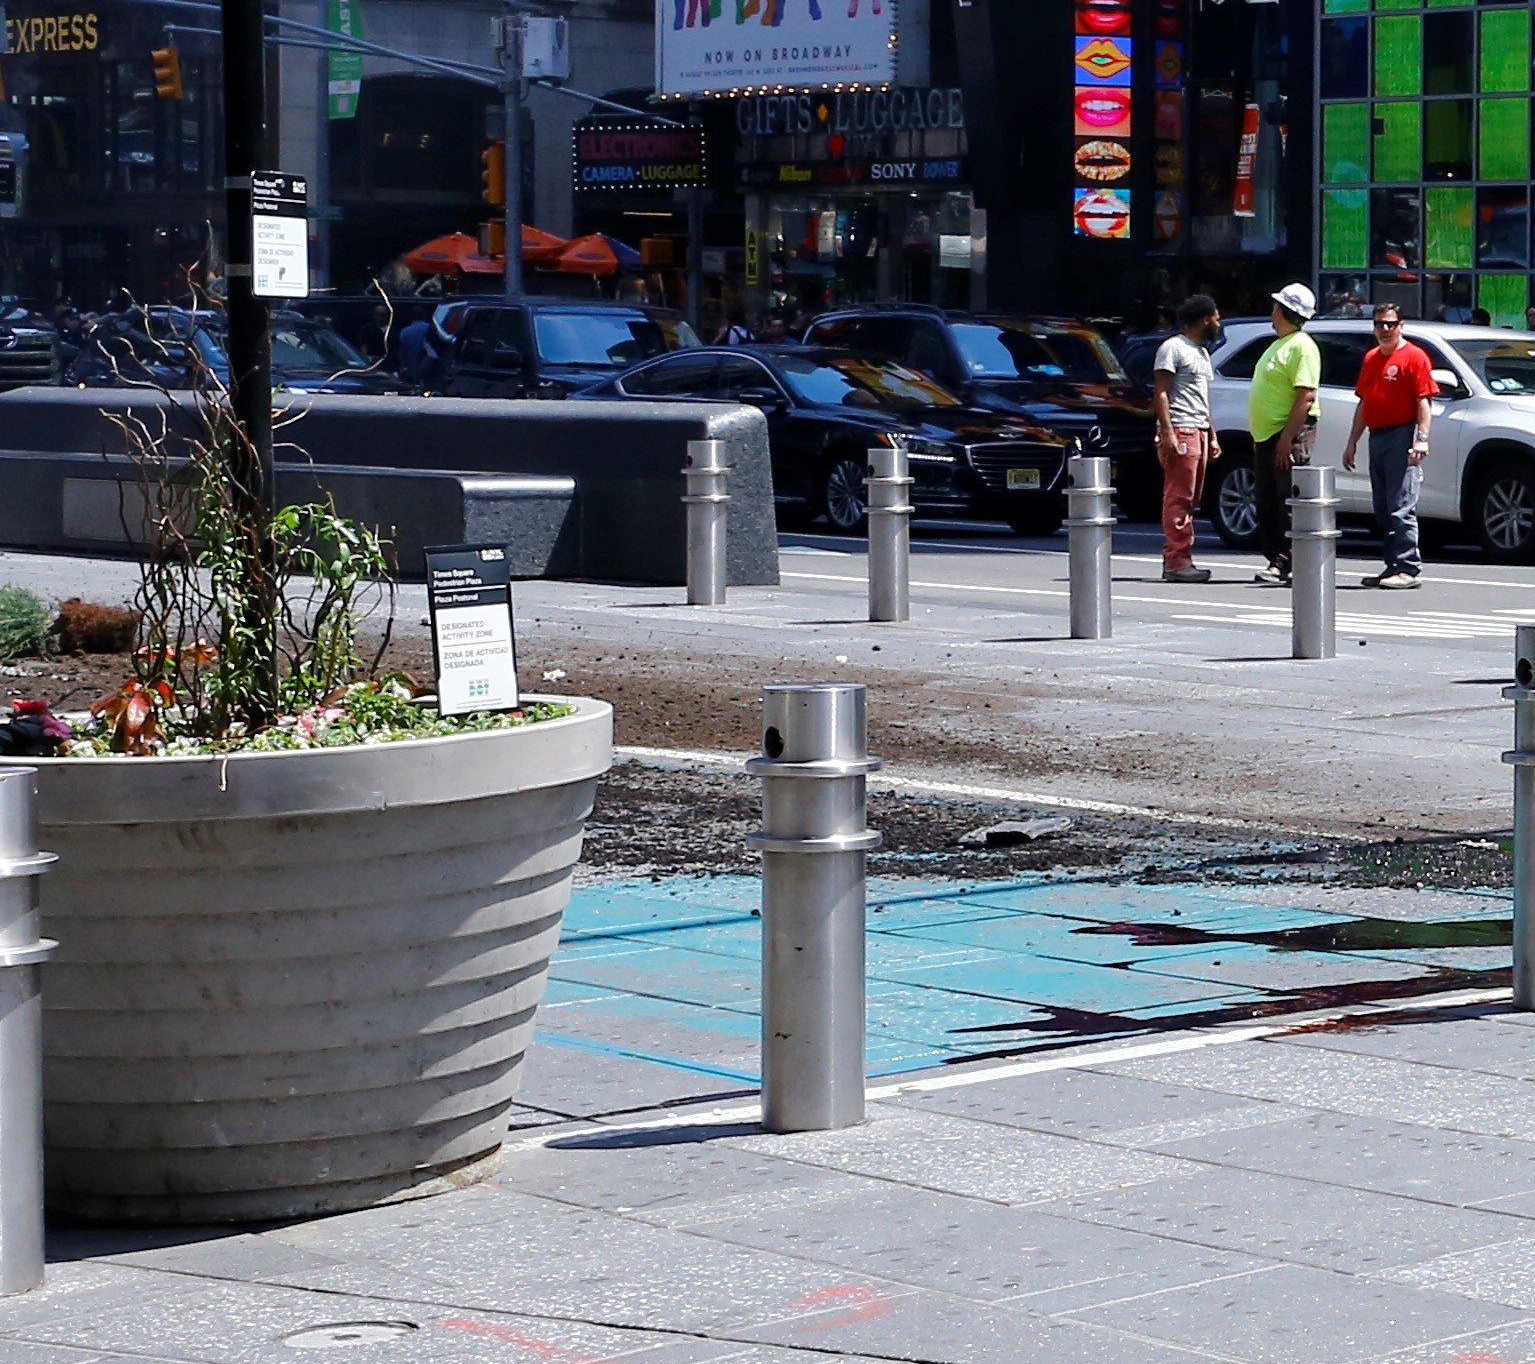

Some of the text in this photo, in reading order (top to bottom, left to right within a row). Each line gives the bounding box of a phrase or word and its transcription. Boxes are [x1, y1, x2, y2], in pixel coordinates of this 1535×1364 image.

[705, 45, 851, 63] NOW ON BROADWAY
[737, 88, 964, 134] GIFTS LUGGAGE
[582, 165, 700, 181] CAMERA LUGGAGE
[871, 163, 916, 179] SONY
[441, 621, 485, 631] DESIGNATED
[442, 630, 493, 641] ACTIVITY ZONE
[444, 651, 462, 660] ZONA
[465, 650, 473, 658] DE
[444, 660, 484, 669] DESIGNADA
